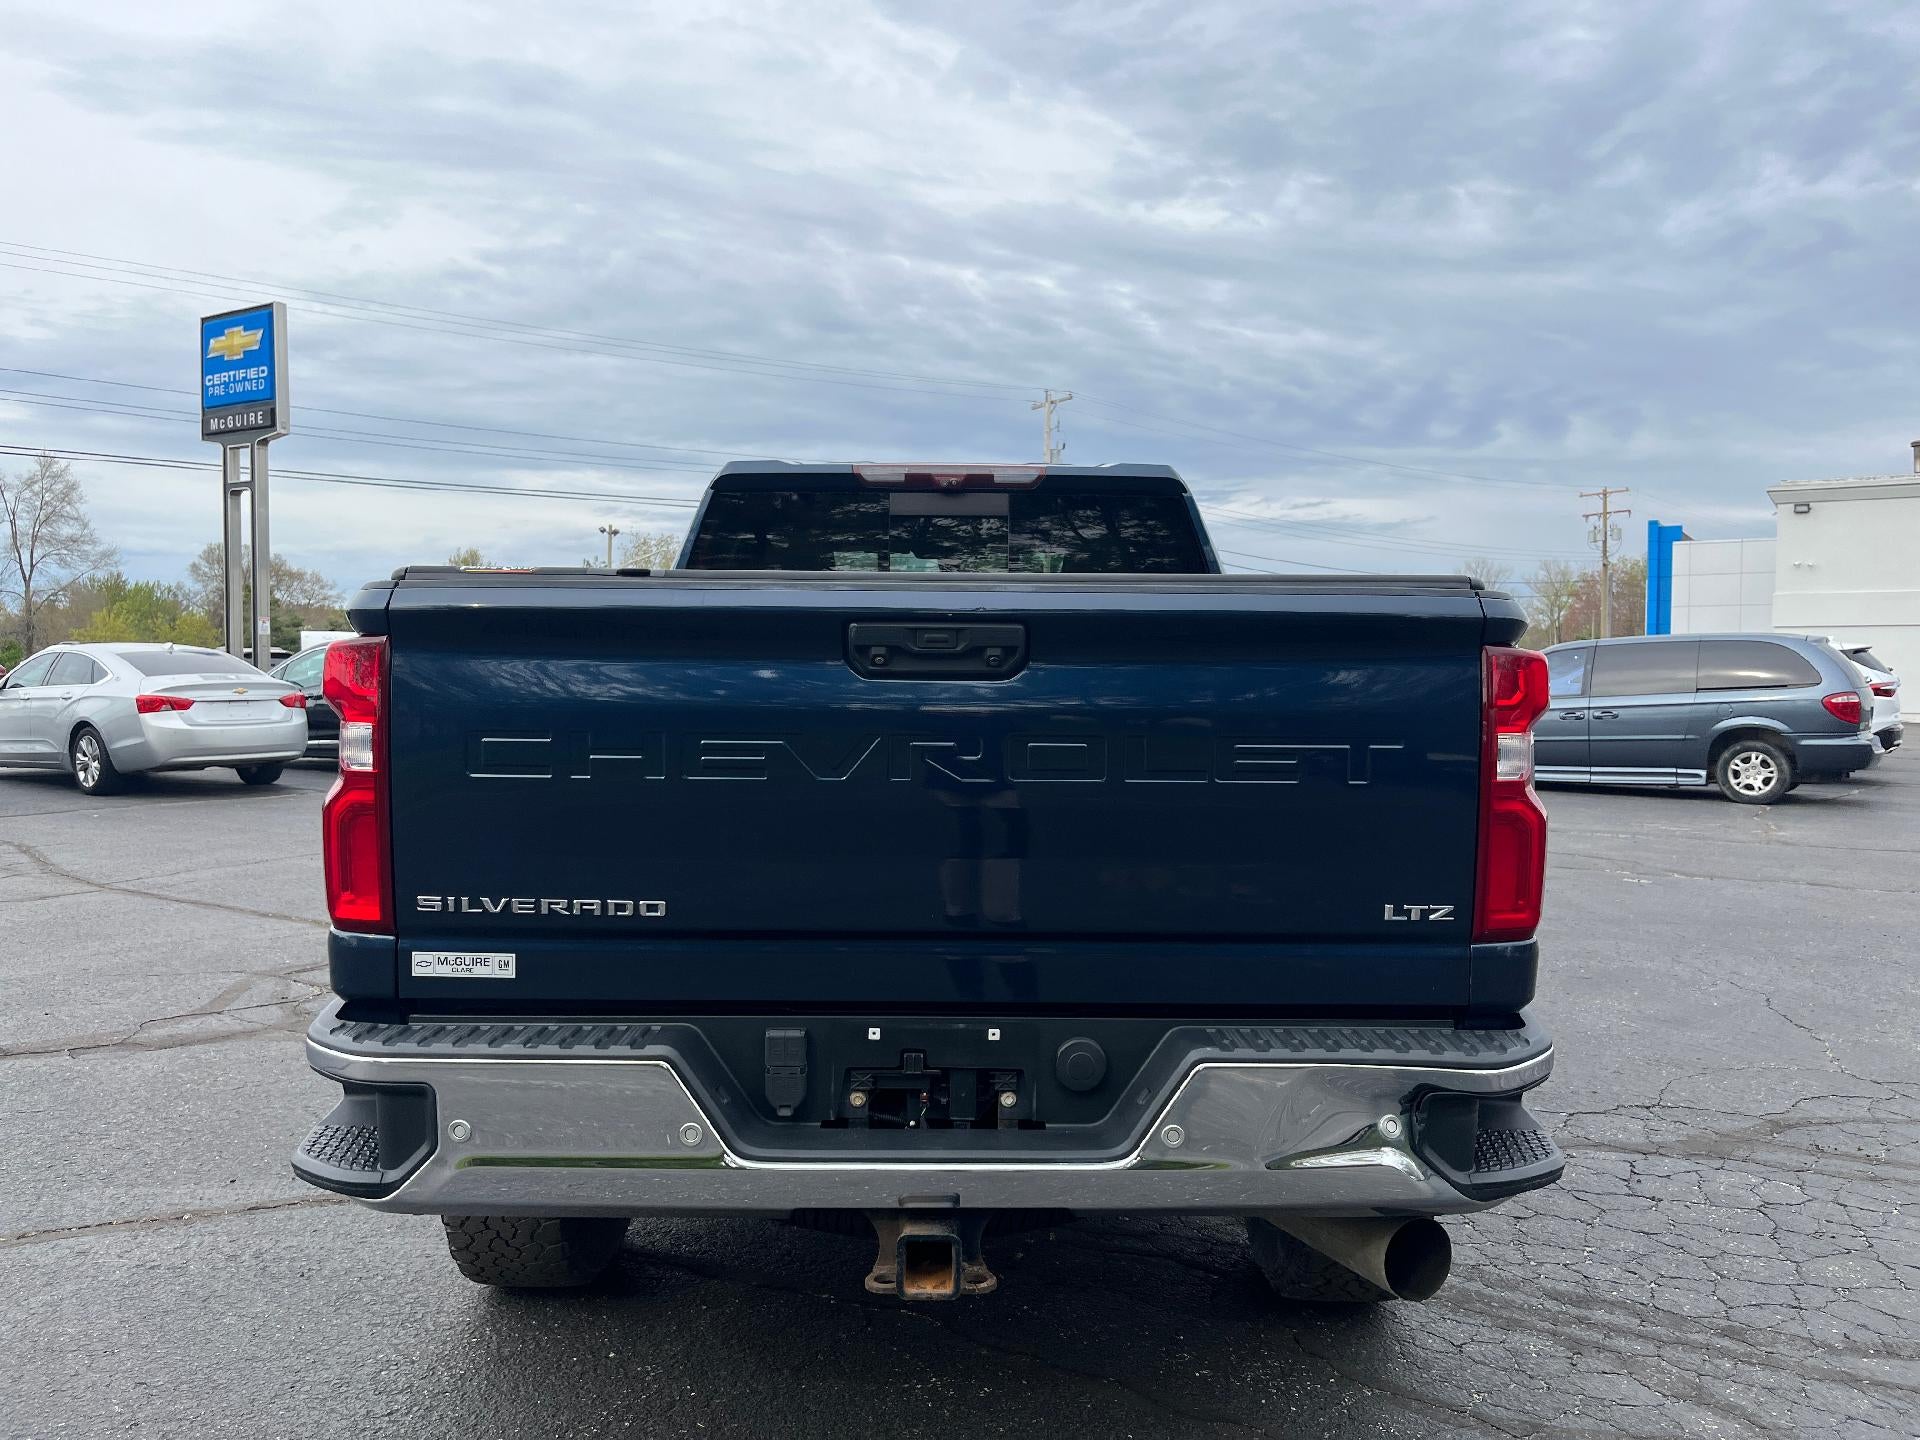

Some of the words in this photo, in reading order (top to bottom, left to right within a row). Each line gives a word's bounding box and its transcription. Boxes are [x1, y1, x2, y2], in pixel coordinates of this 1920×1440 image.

[205, 366, 268, 385] CERTIFIED
[208, 379, 265, 397] PRE-OWNED
[210, 411, 264, 430] McGUIRE
[466, 730, 1404, 784] CHEVROLET
[416, 895, 666, 917] SILVERADO
[1384, 904, 1455, 921] LTZ
[437, 956, 491, 967] McGUIRE
[498, 959, 510, 969] GM
